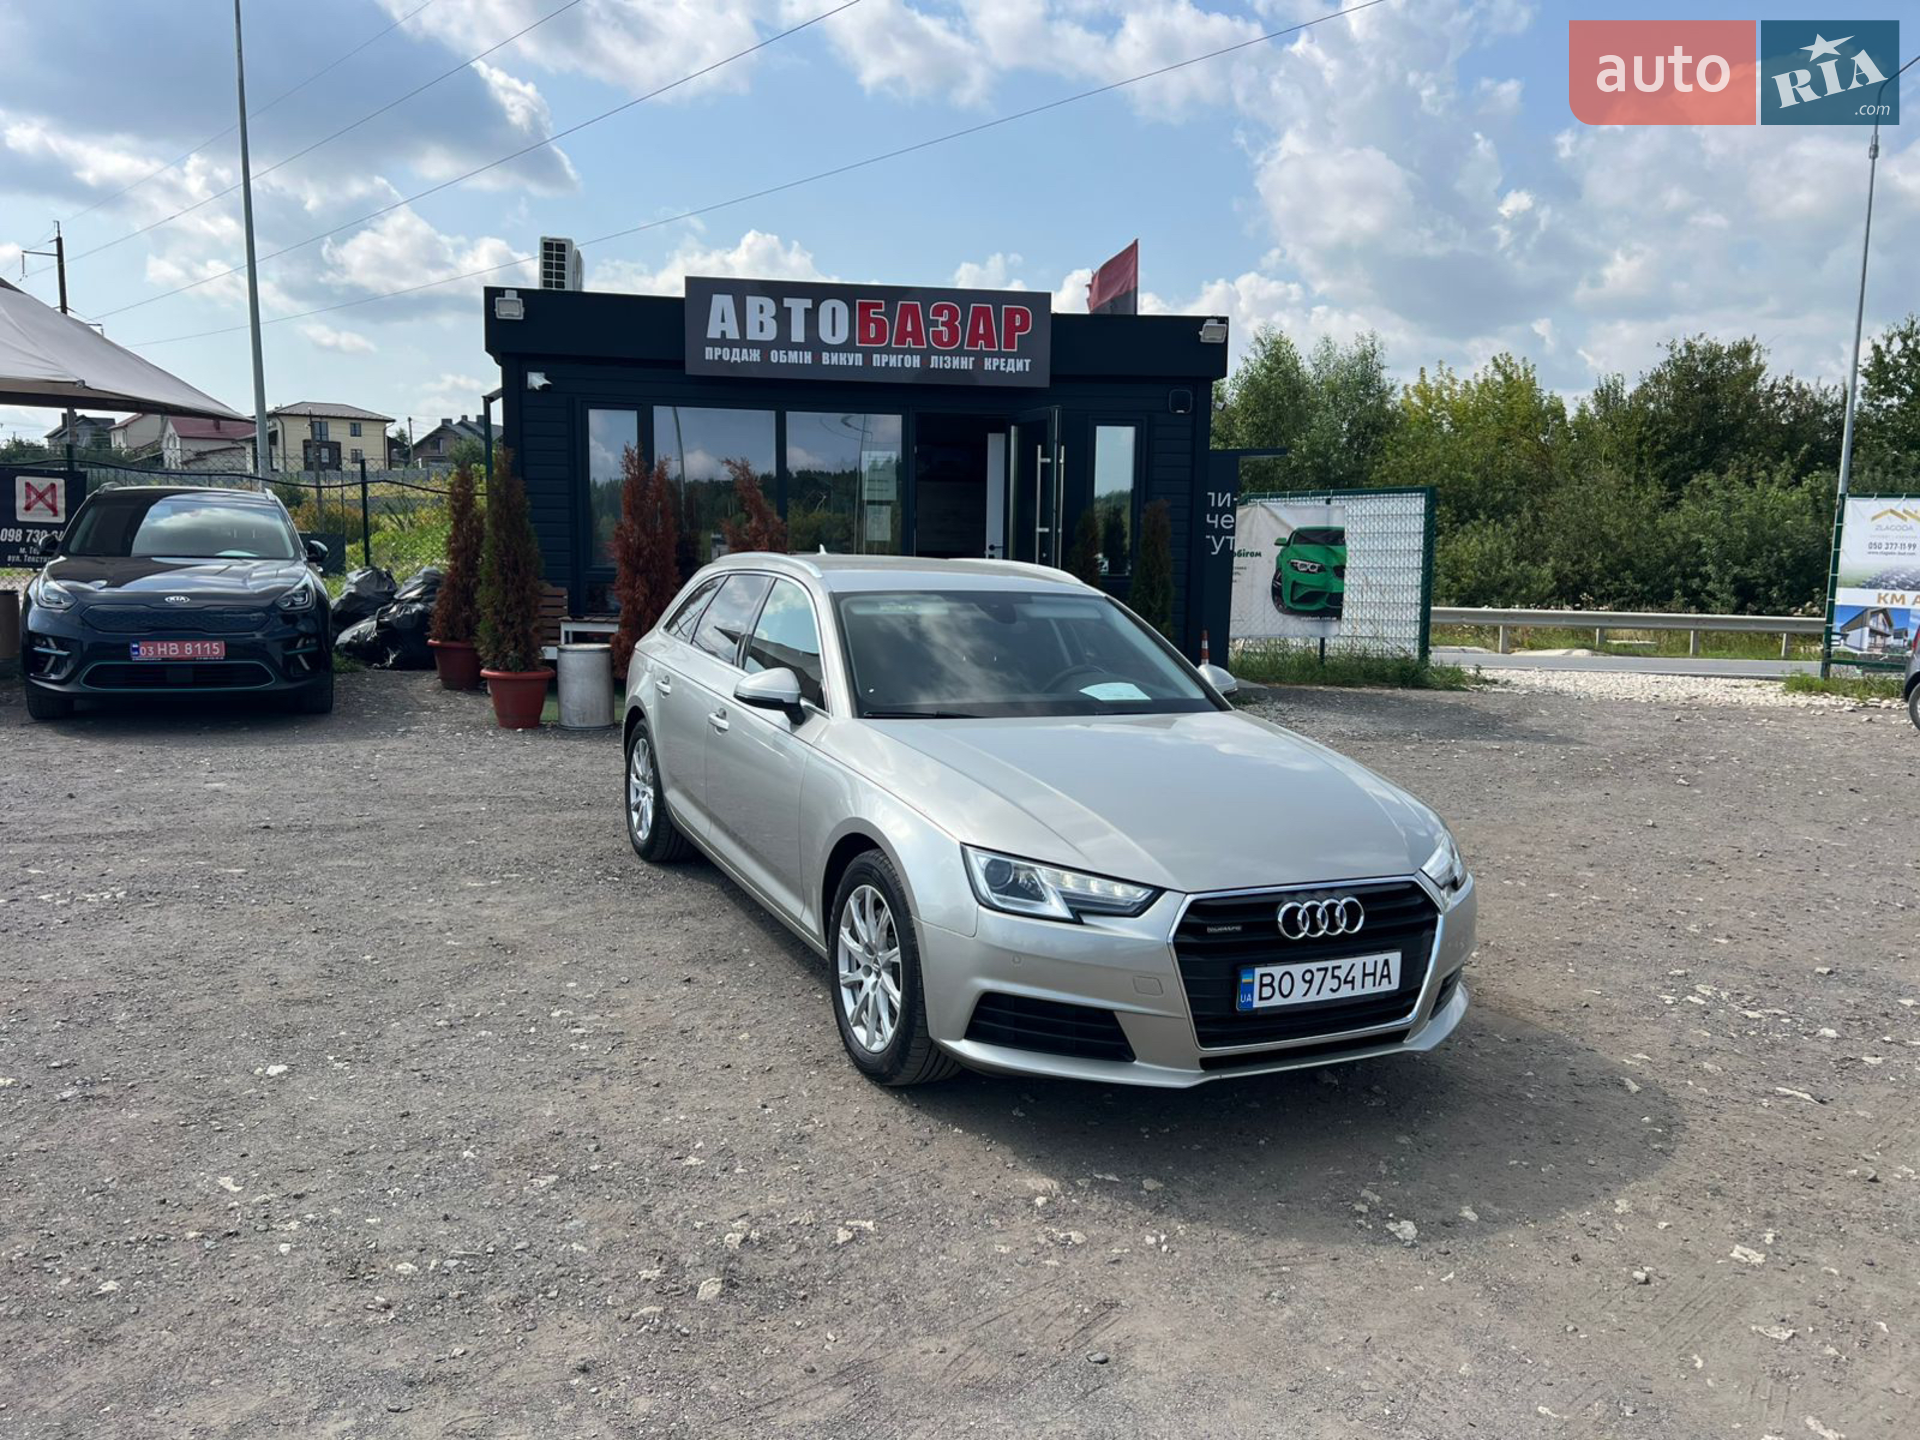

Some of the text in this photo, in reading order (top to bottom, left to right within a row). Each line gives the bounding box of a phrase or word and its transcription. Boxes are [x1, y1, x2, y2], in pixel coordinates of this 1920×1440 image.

[706, 293, 1033, 352] АВТОБАЗАР
[705, 347, 1032, 373] ПРОДАЖ ОБМІН ВИКУП ПРИГОН ЛІЗИНГ КРЕДИТ
[0, 528, 23, 542] 098
[1205, 535, 1235, 555] ут
[140, 642, 220, 656] 03 HB 8115
[1258, 958, 1392, 1001] BO 9754 HA
